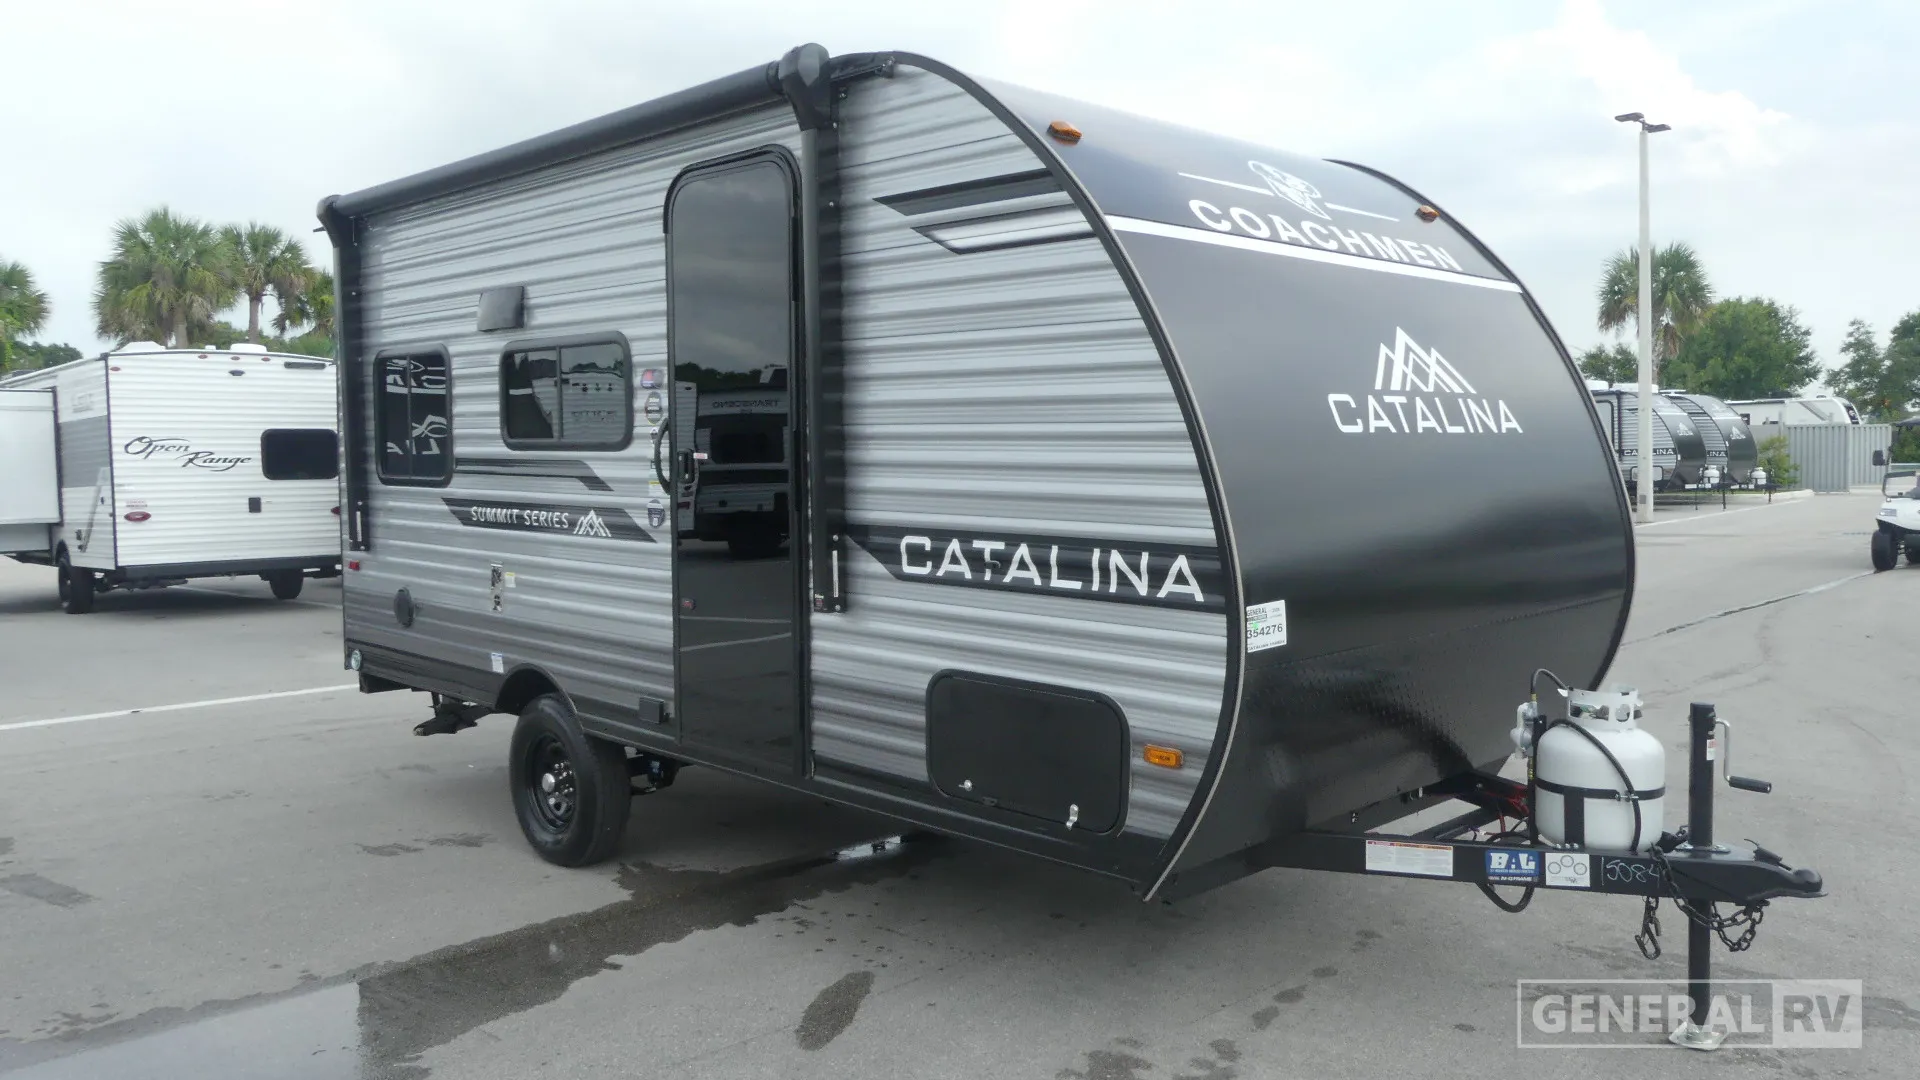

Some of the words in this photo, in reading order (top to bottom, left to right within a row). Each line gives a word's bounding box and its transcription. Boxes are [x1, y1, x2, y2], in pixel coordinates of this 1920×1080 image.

[1188, 199, 1463, 272] COACHMEN
[1327, 393, 1523, 435] CATALINA
[124, 436, 190, 460] Open
[175, 451, 252, 472] Range
[471, 506, 519, 524] SUMMIT
[523, 509, 569, 528] SERIES
[899, 535, 1205, 602] CATALINA
[1246, 624, 1283, 639] 354276
